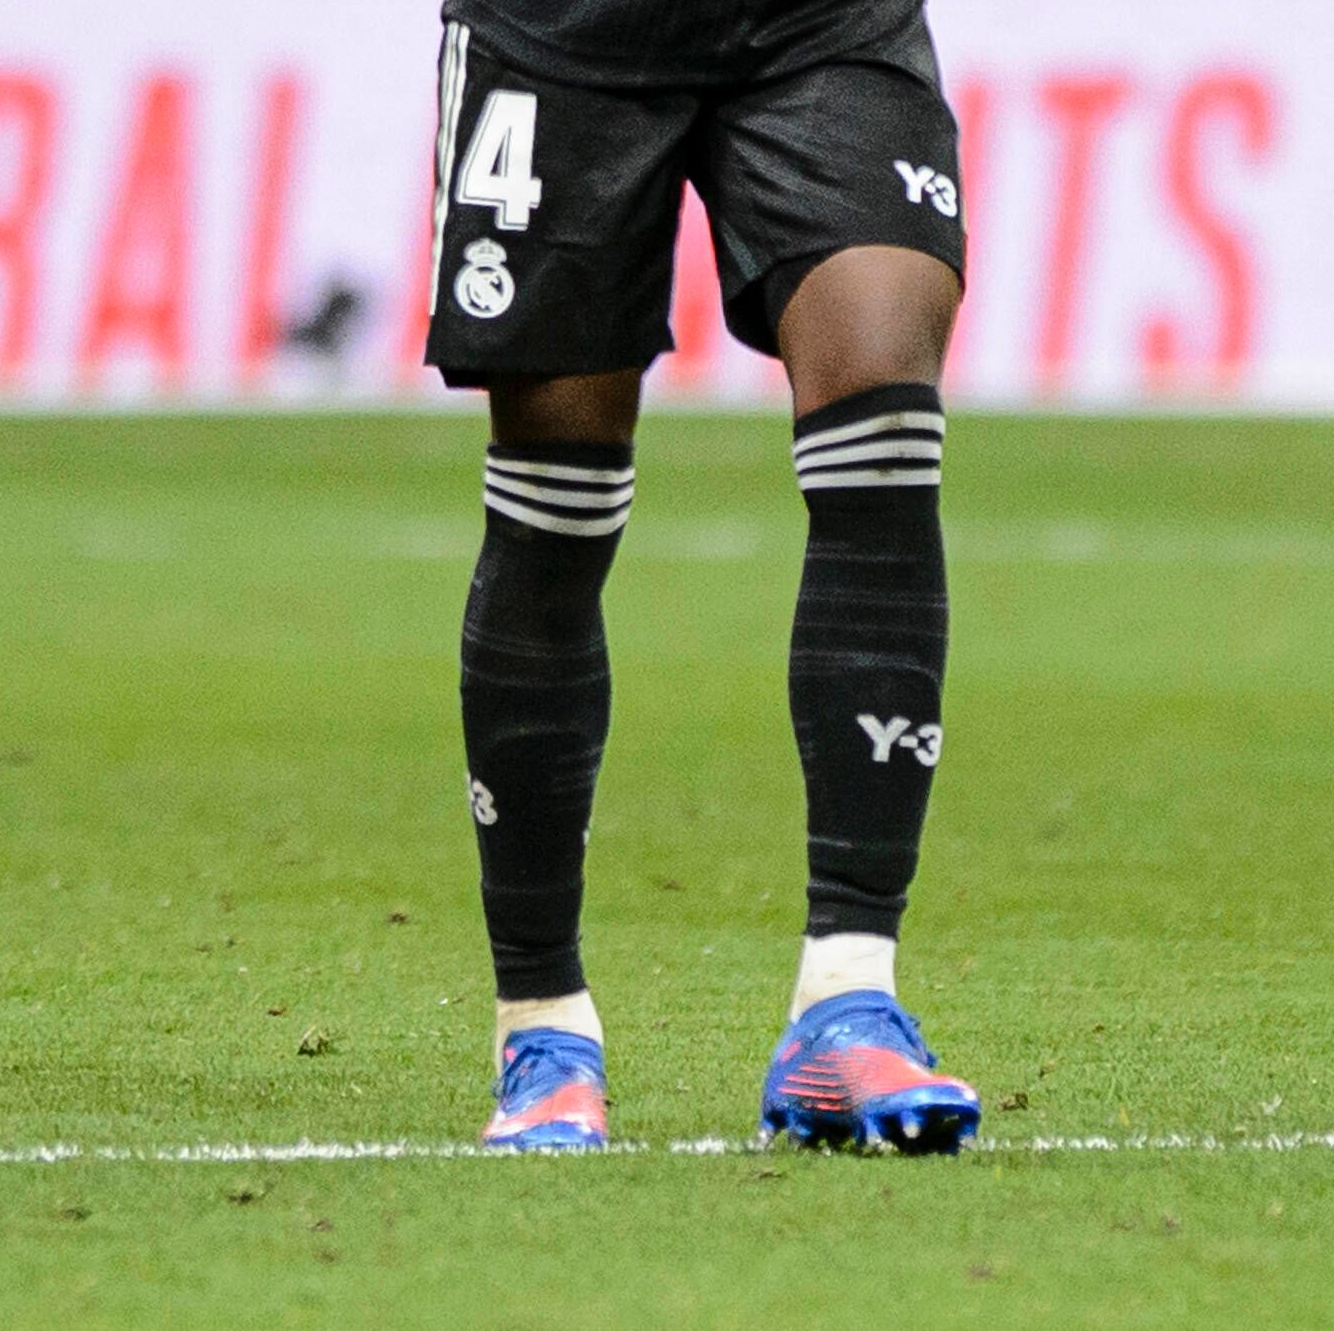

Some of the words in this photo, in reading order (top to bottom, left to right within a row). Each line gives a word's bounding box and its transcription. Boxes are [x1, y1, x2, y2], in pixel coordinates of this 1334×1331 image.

[454, 88, 543, 232] 4
[893, 158, 958, 218] Y-3
[856, 713, 943, 767] Y-3
